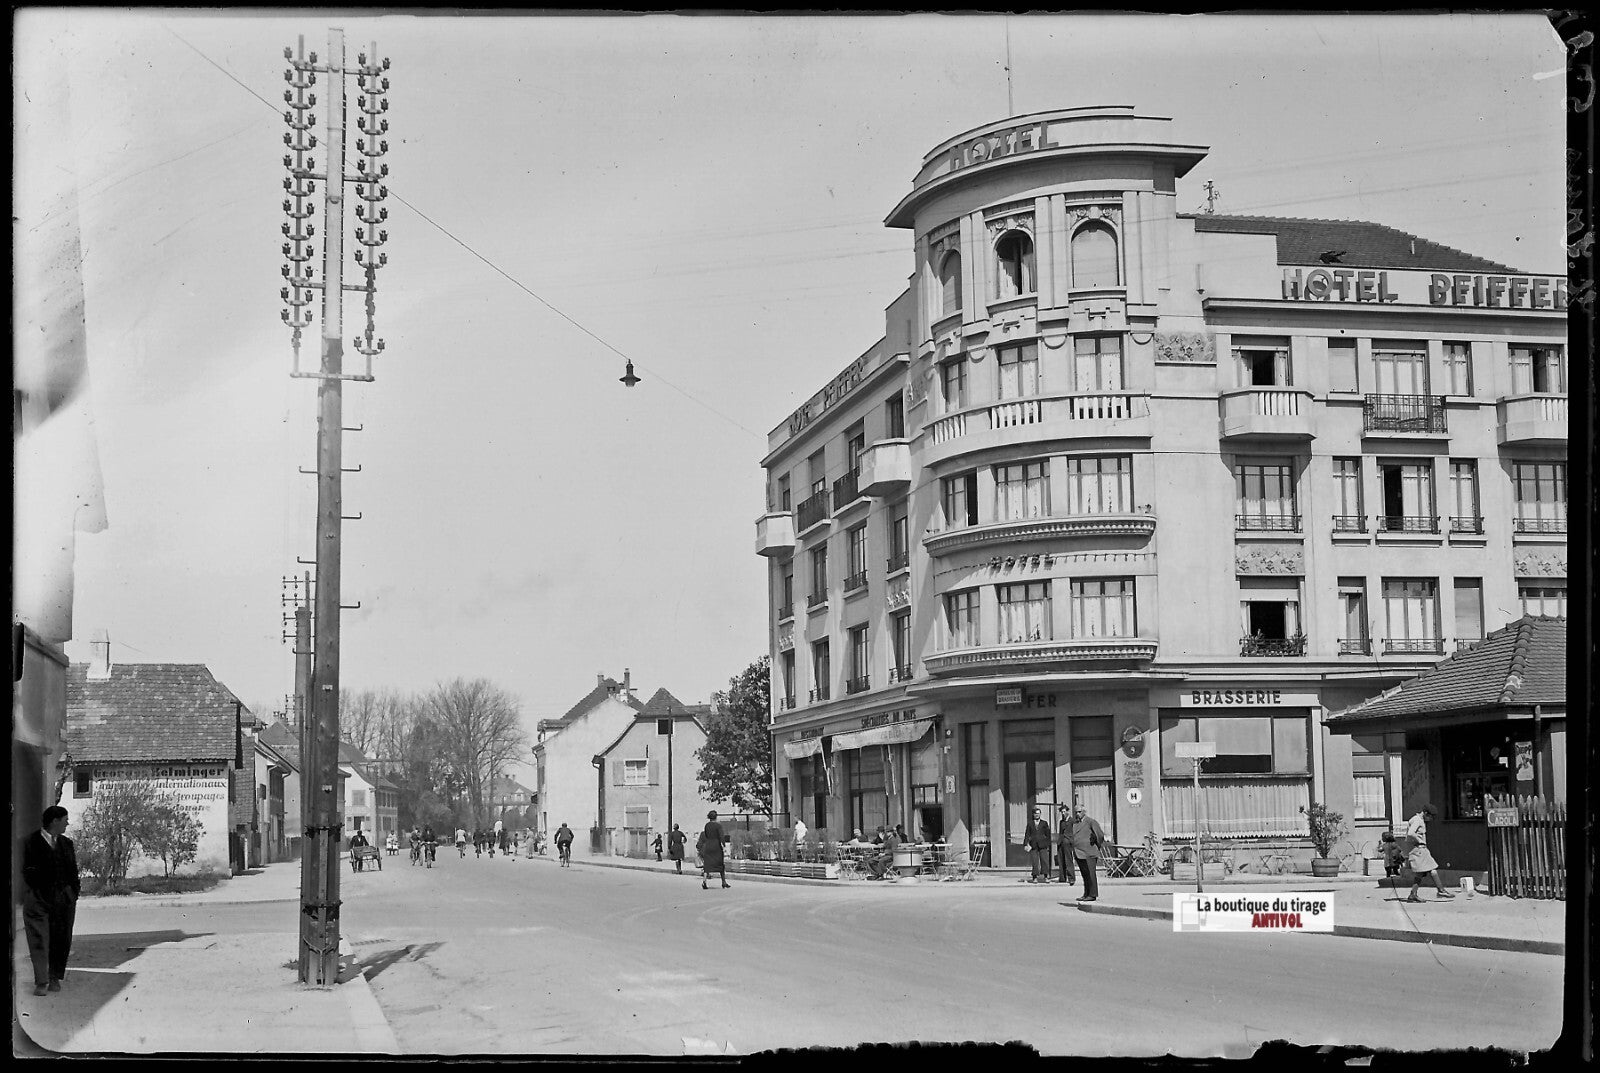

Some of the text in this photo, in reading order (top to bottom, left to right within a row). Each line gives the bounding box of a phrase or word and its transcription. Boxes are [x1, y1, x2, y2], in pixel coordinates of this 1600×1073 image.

[950, 121, 1059, 170] HOTEL
[1282, 269, 1399, 302] HOTEL
[1192, 690, 1281, 704] BRASSERIE
[153, 777, 227, 789] Internationaux
[172, 790, 225, 803] Groupages
[1488, 810, 1517, 826] CAROLA
